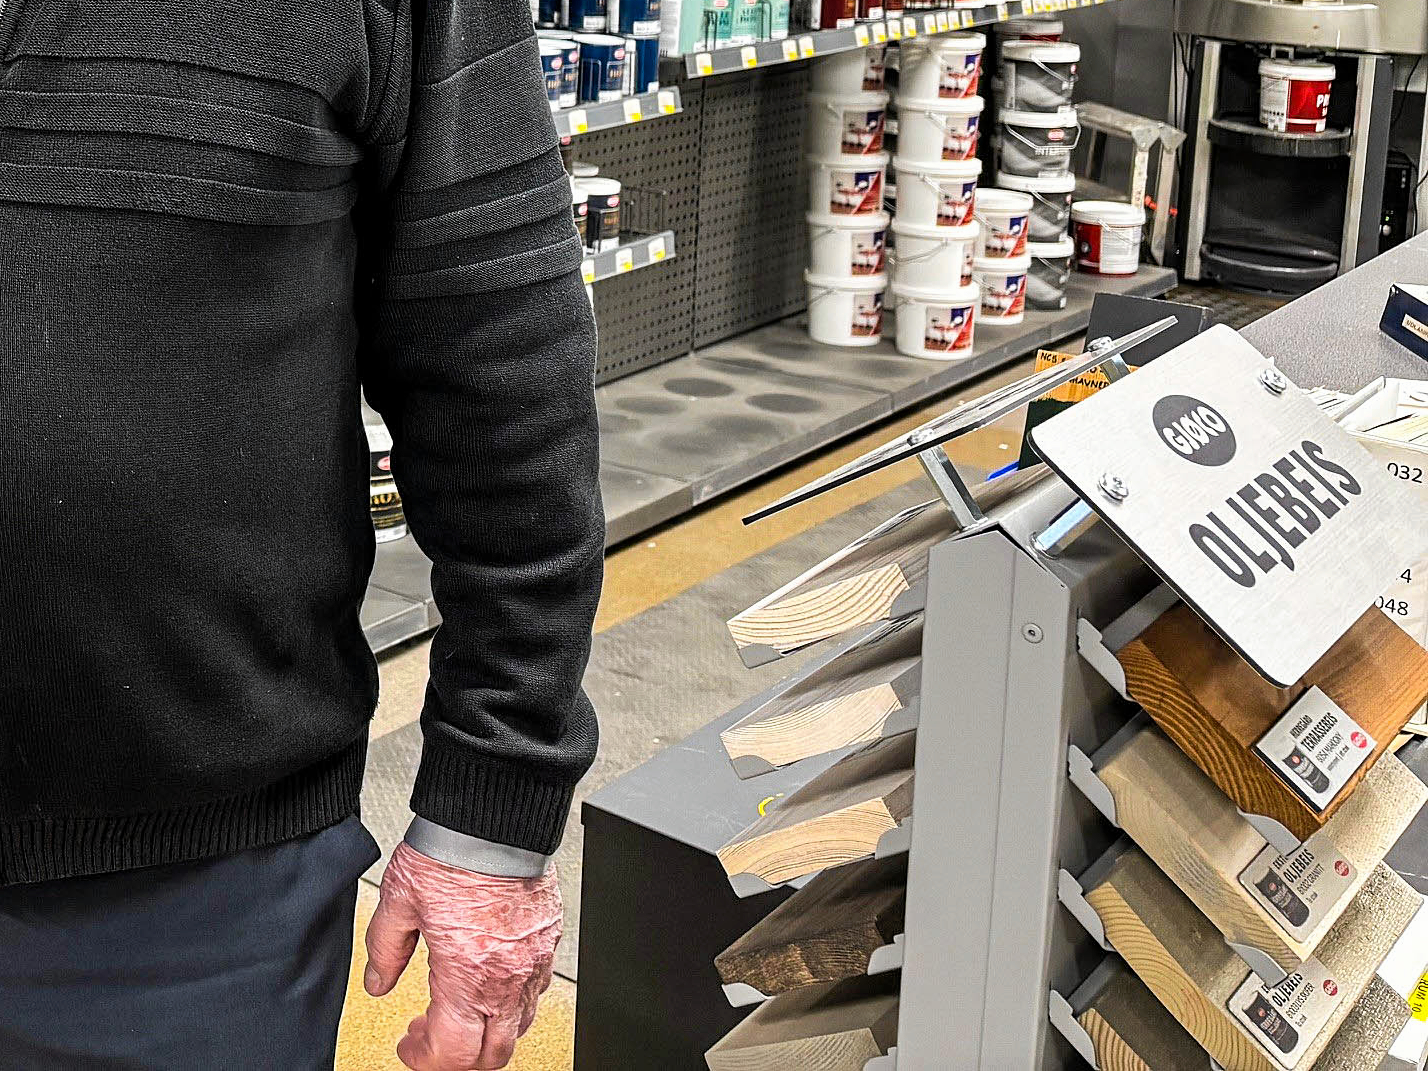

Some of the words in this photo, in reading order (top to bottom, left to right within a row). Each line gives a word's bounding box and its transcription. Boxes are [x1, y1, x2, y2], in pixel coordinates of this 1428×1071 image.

[1161, 405, 1228, 456] GJØCO
[1188, 440, 1362, 588] OLJEBEIS
[1300, 712, 1339, 752] TERRASSEBEIS
[1283, 848, 1315, 884] OLJEBEIS
[1272, 973, 1303, 1007] OLJEBEIS
